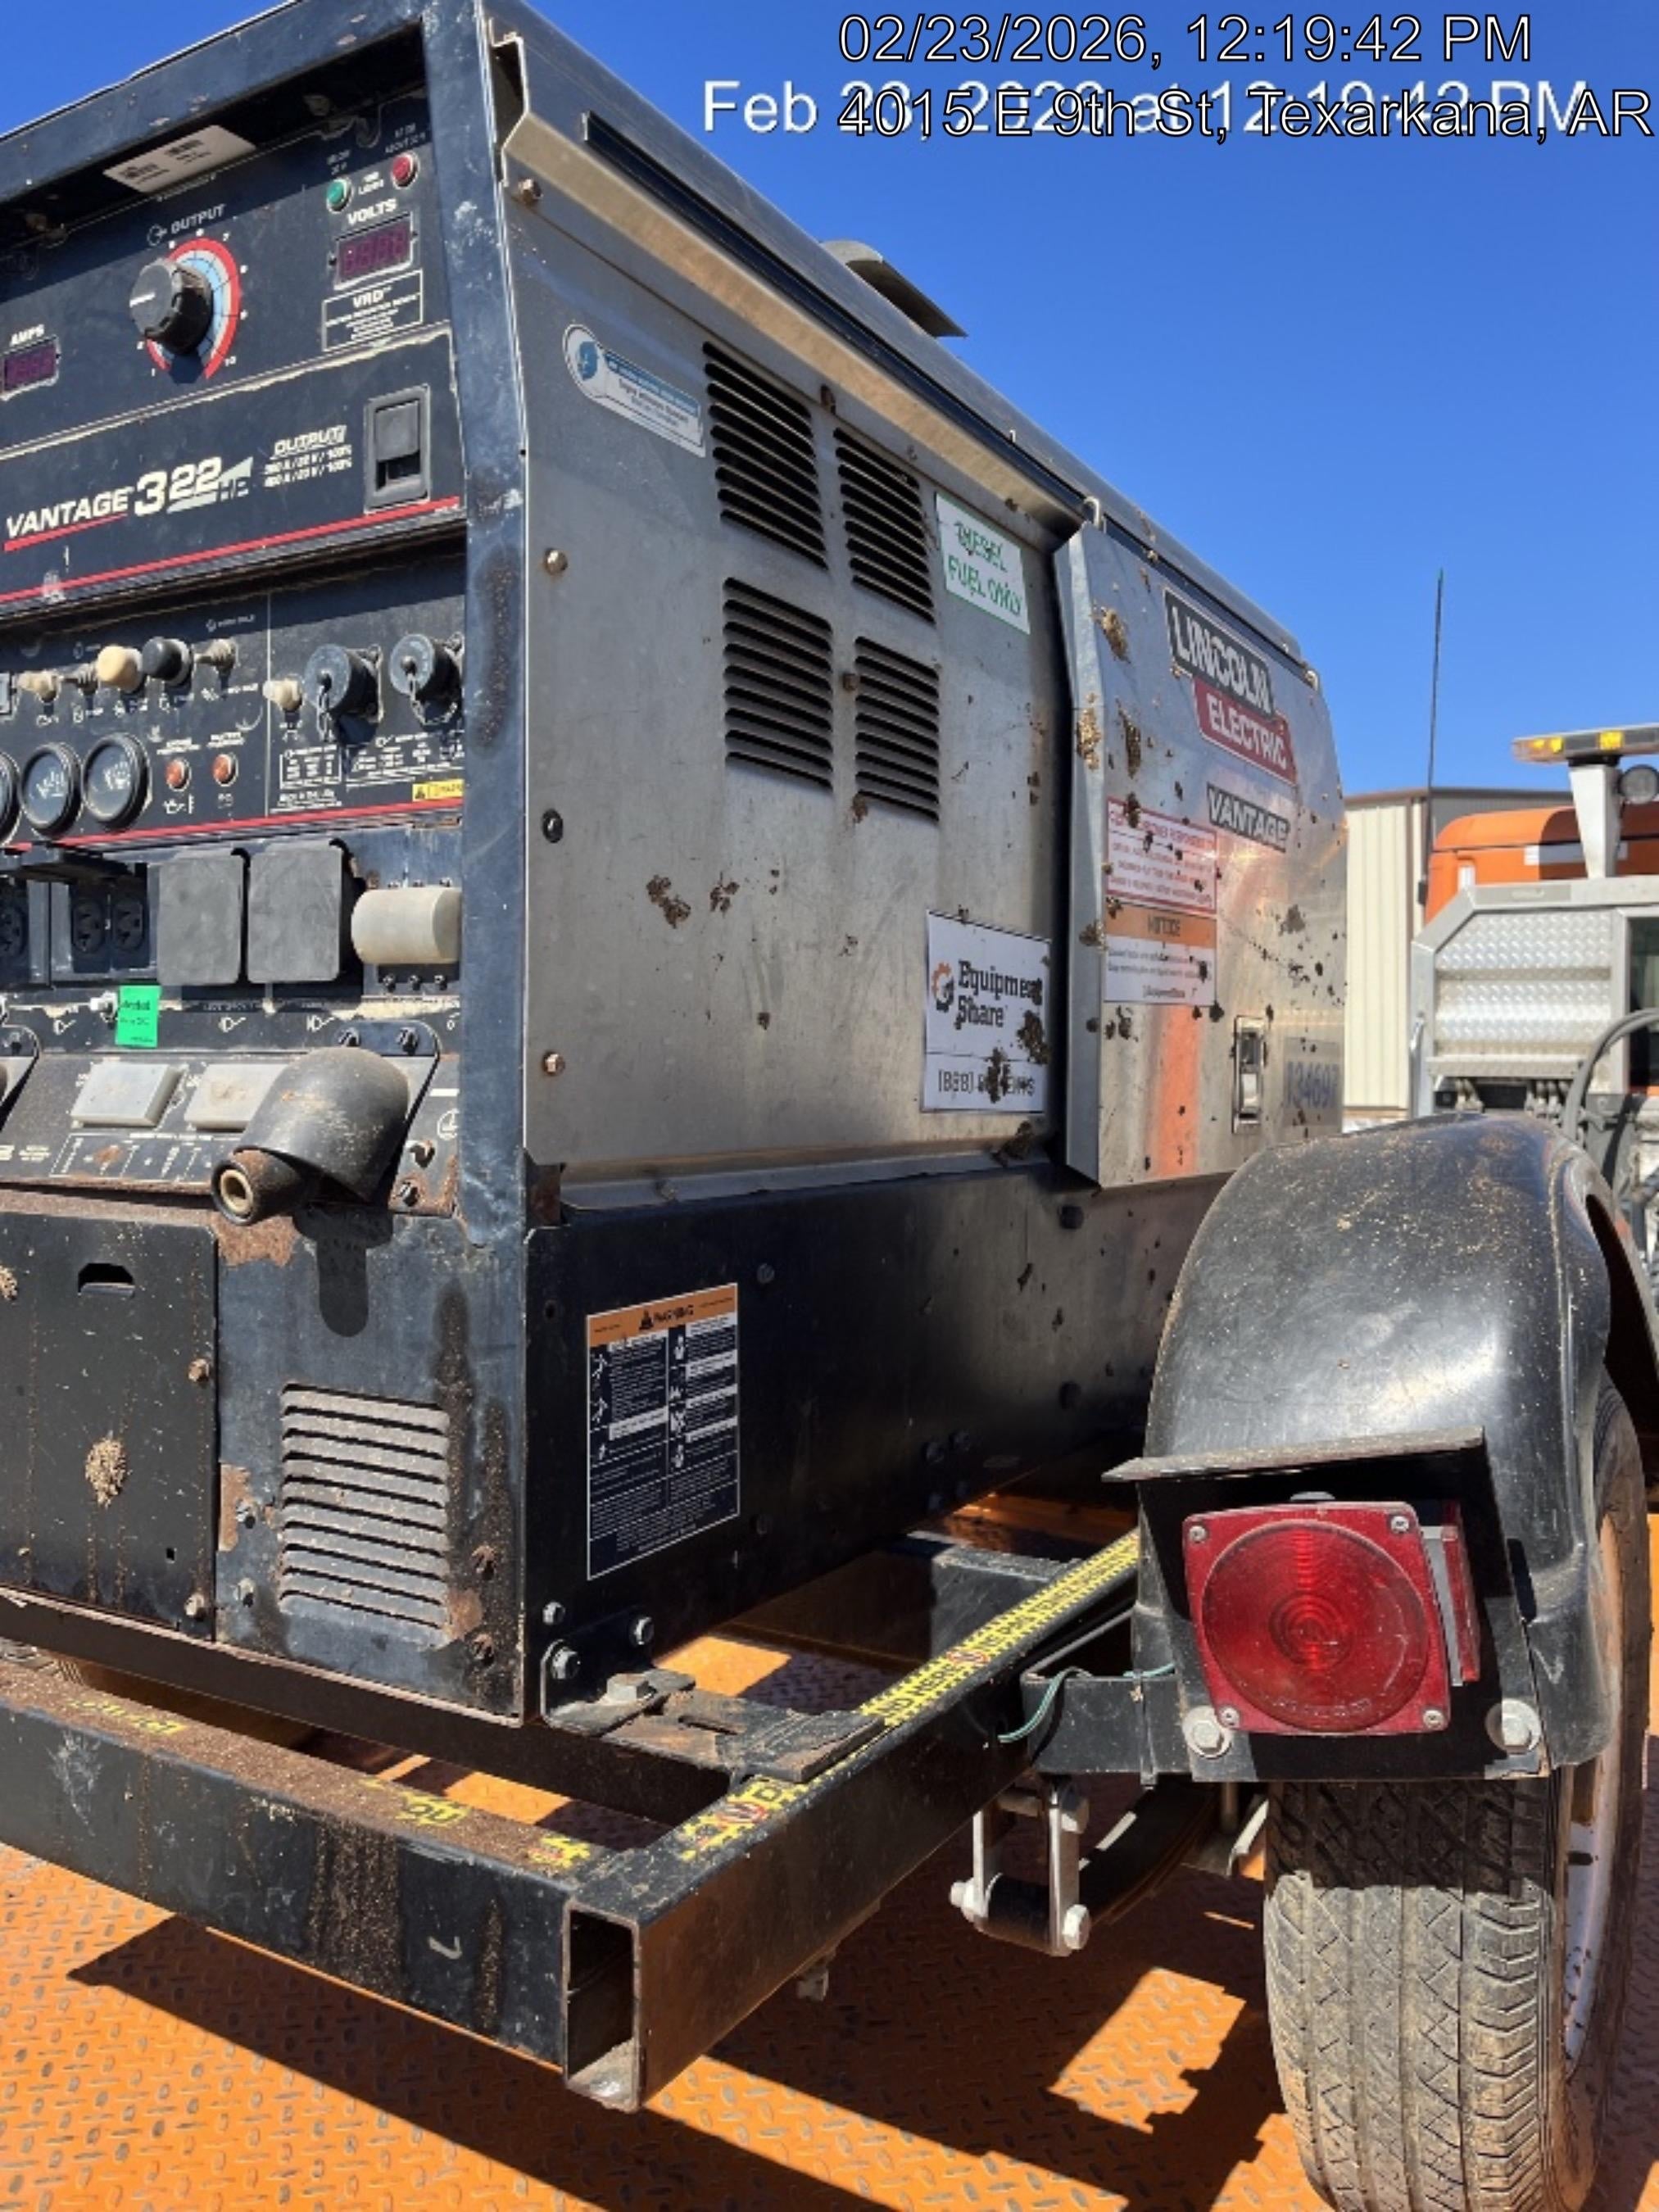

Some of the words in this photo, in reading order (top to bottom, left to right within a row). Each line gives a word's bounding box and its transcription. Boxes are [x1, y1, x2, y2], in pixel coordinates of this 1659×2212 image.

[170, 204, 225, 235] OUTPUT
[347, 197, 397, 225] VOLTS
[6, 486, 135, 539] VANTAGE
[134, 456, 223, 517] 322
[1171, 605, 1271, 715] LINCOLN
[1206, 691, 1287, 772] ELECTRIC
[1208, 790, 1290, 846] VANTAGE
[957, 995, 1004, 1028] Share
